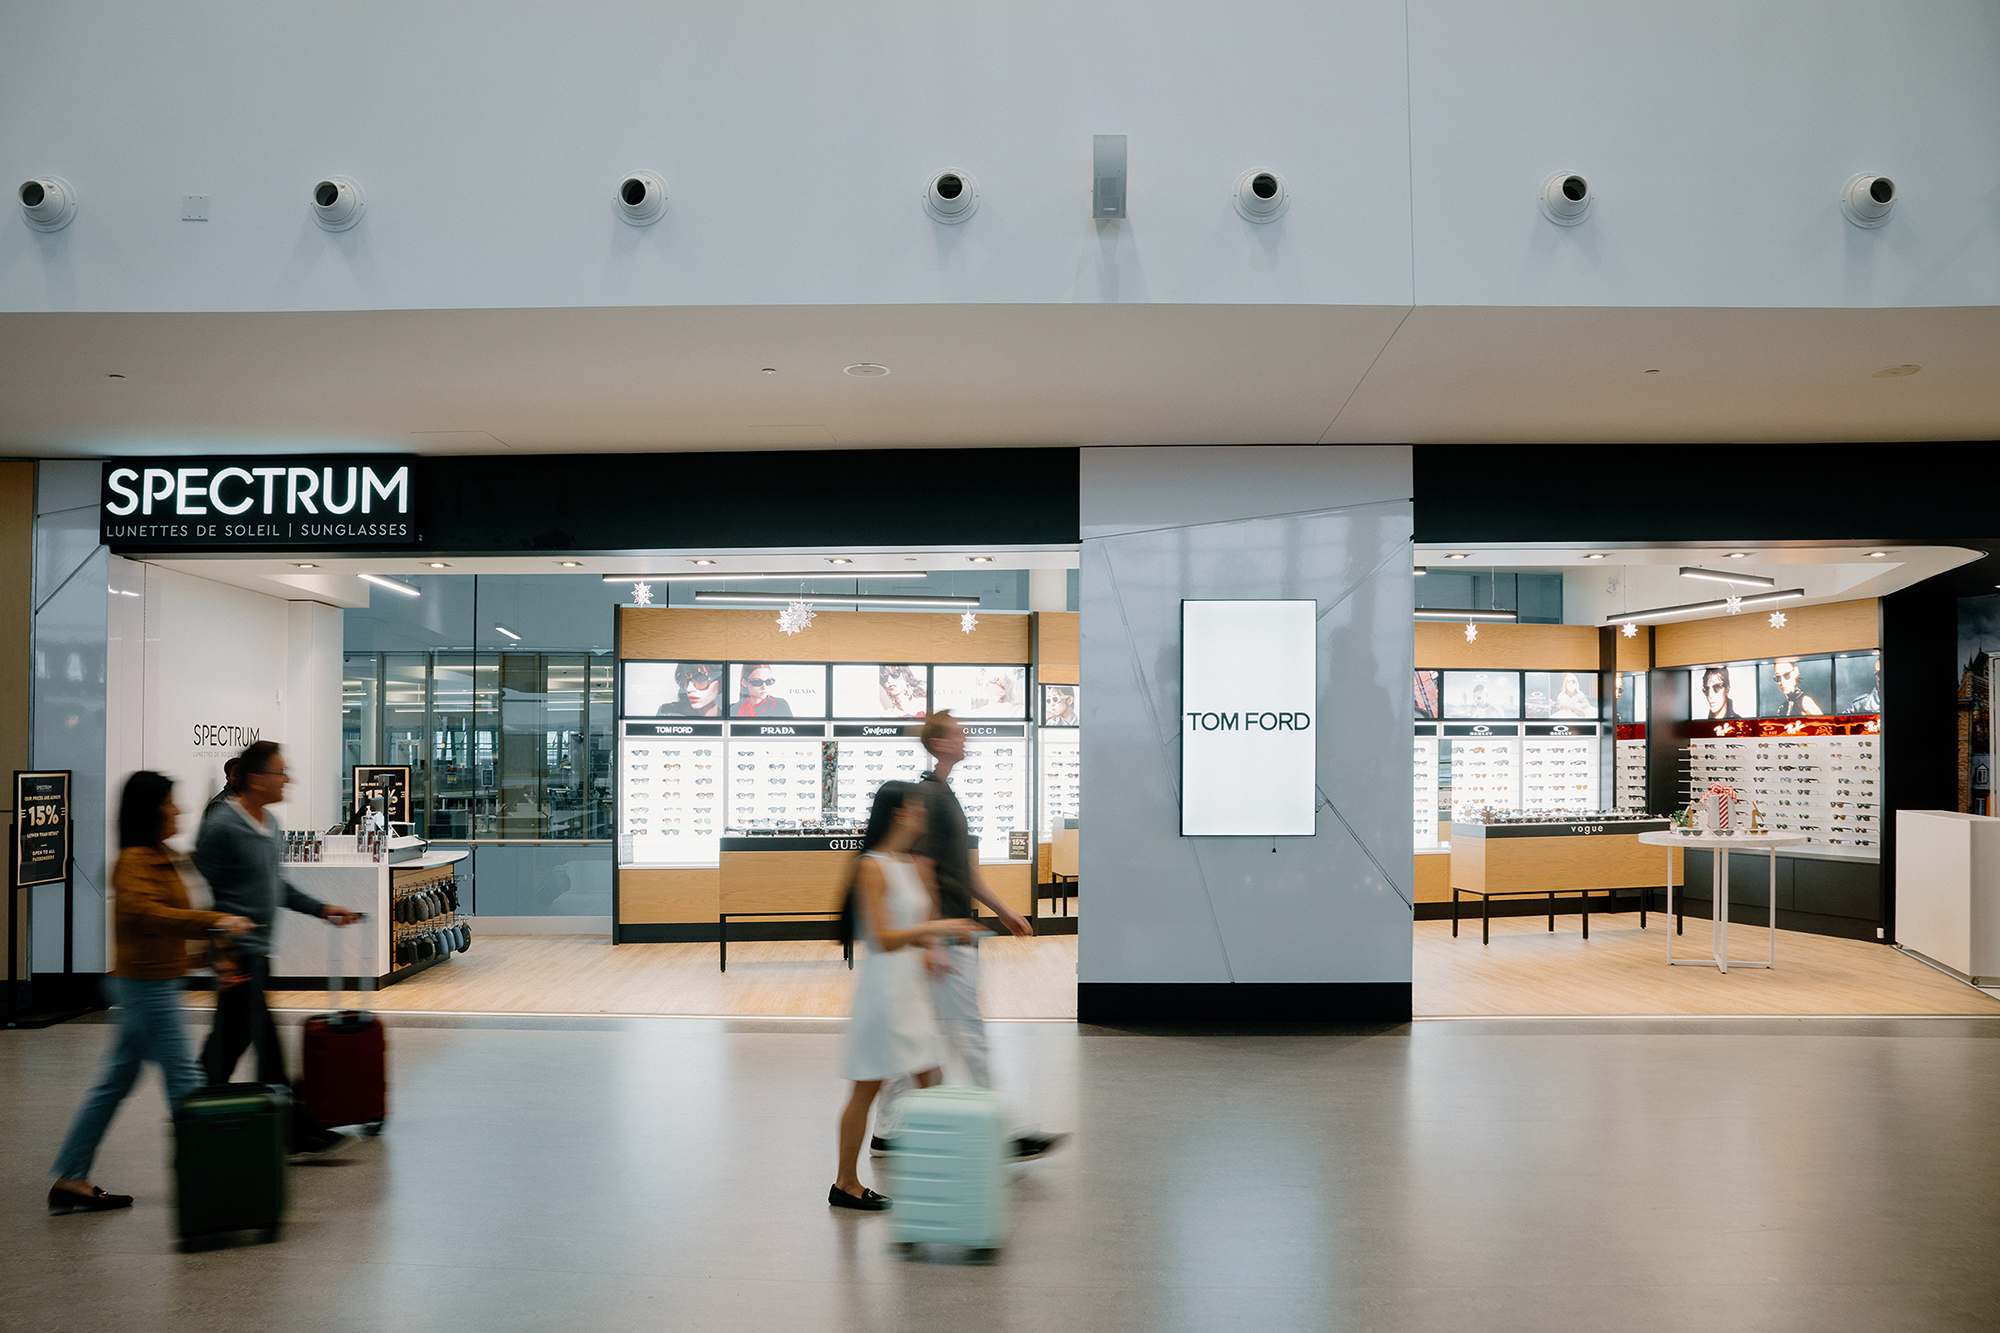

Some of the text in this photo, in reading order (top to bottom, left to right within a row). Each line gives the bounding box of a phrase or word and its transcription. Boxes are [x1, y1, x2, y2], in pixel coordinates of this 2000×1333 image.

[106, 466, 409, 516] SPECTRUM
[106, 523, 408, 538] LUNETTES DE SOLEIL SUNGLASSES
[1186, 712, 1311, 731] TOM FORD
[193, 724, 260, 747] SPECTRUM
[655, 726, 693, 734] TOM FORD
[760, 726, 795, 735] PRADA
[963, 727, 997, 735] GUCCI
[28, 805, 59, 826] 15%
[1570, 825, 1604, 835] vogue
